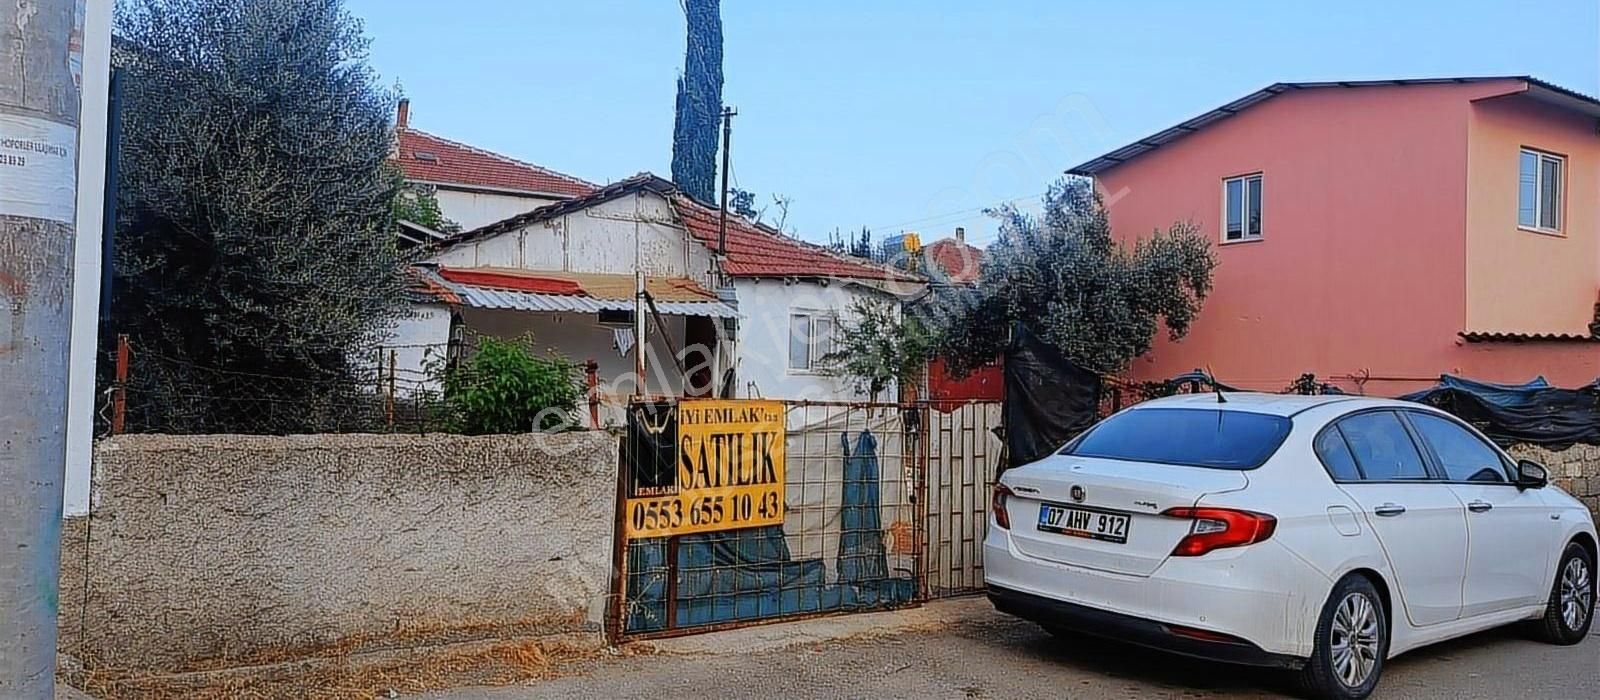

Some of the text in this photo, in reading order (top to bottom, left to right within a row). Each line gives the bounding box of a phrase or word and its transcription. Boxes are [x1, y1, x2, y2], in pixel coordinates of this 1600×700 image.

[680, 432, 778, 491] SATILIK
[633, 491, 778, 531] 0553 655 10 43
[1048, 508, 1065, 526] 07
[1066, 510, 1091, 530] AHV
[1097, 515, 1125, 535] 912
